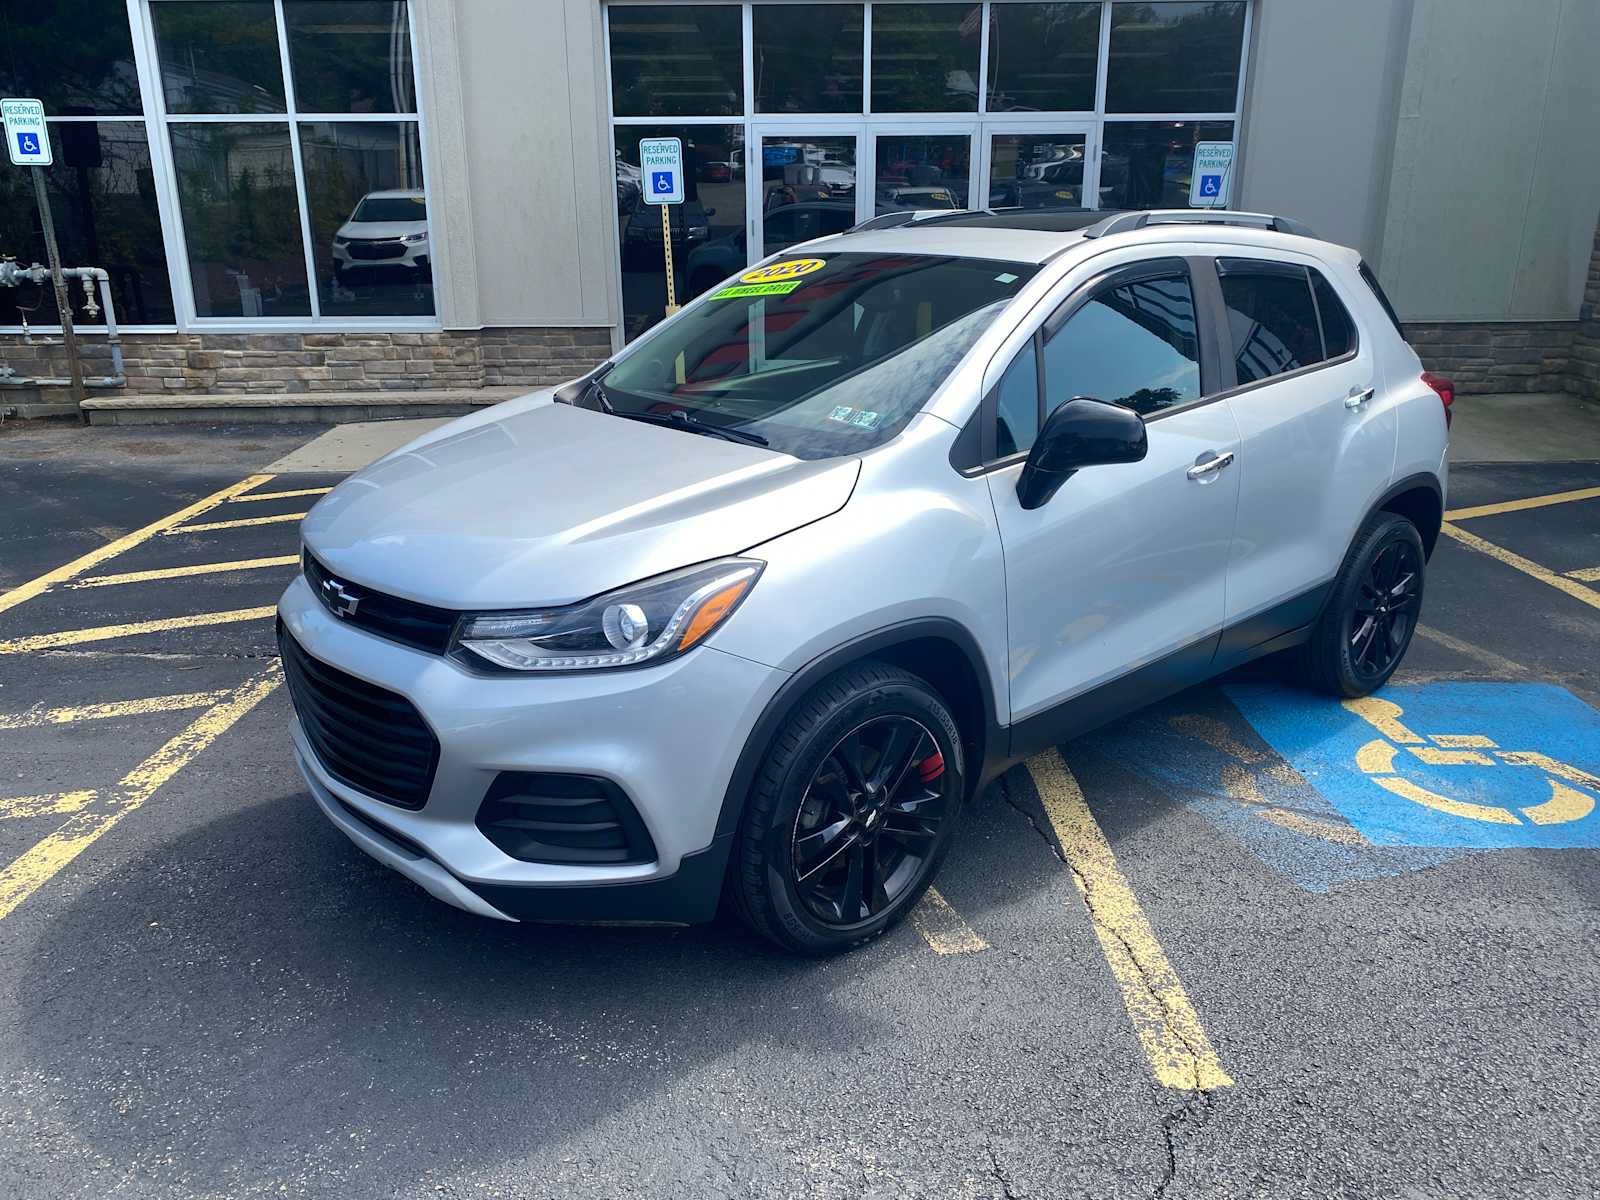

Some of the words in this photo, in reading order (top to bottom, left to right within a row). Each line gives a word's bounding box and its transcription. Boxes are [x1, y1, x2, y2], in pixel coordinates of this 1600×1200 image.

[4, 105, 40, 115] RESERVED
[9, 117, 40, 126] PARKING
[643, 144, 678, 154] RESERVED
[1198, 148, 1232, 158] RESERVED
[646, 156, 677, 165] PARKING
[1198, 159, 1228, 169] PARKING
[750, 261, 818, 280] 2020
